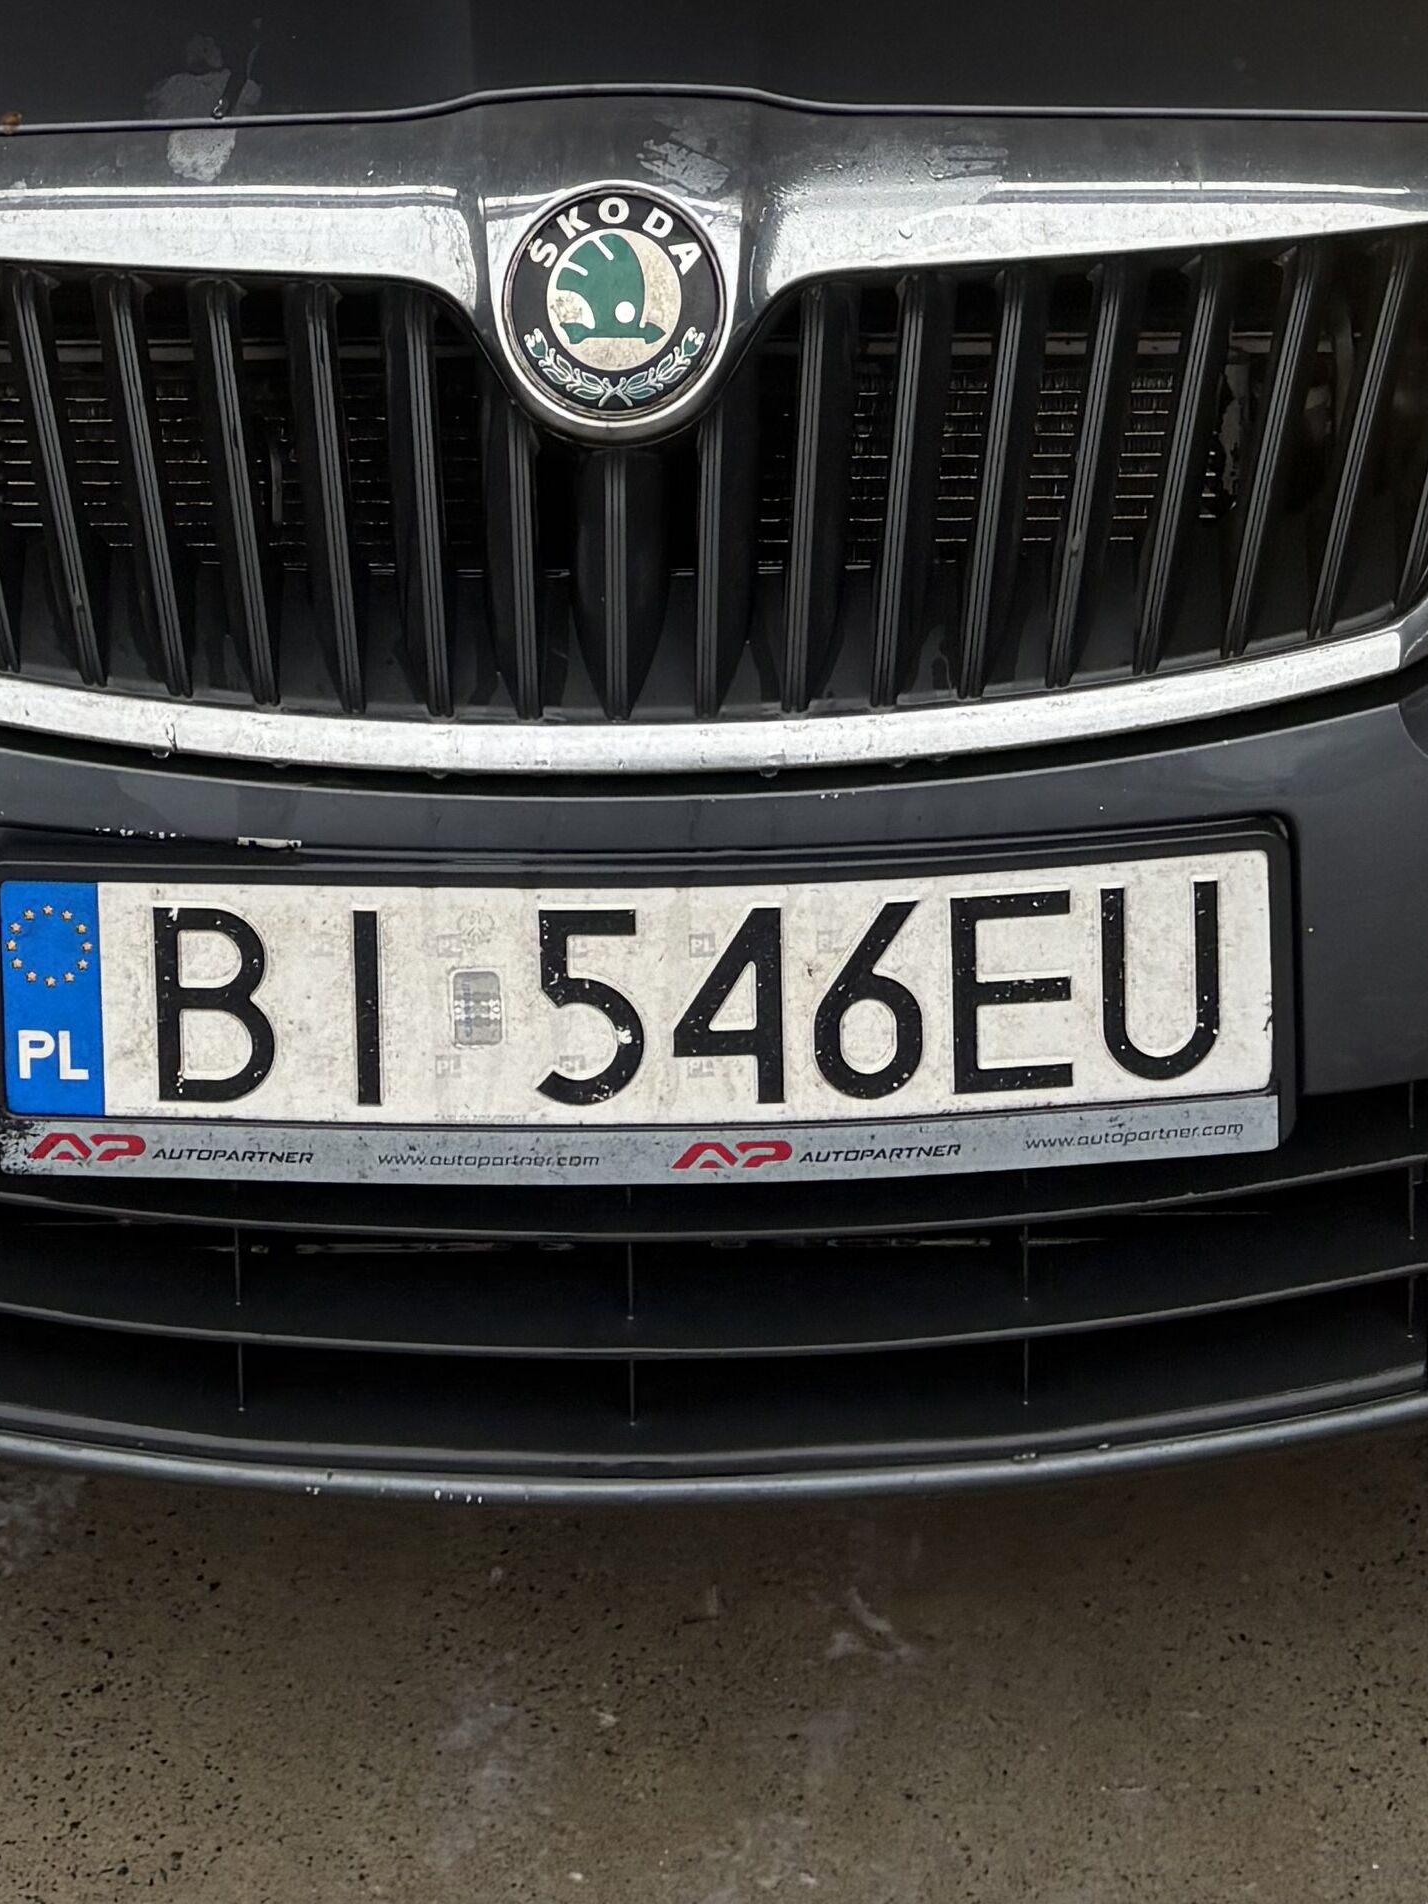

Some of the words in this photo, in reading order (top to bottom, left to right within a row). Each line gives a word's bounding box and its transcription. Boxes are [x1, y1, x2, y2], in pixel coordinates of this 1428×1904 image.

[537, 880, 1224, 1105] 546EU
[18, 1032, 90, 1081] PL
[152, 1147, 315, 1166] AUTOPARTNER
[798, 1142, 963, 1164] AUTOPARTNER
[1024, 1119, 1246, 1150] www.autopartner.com
